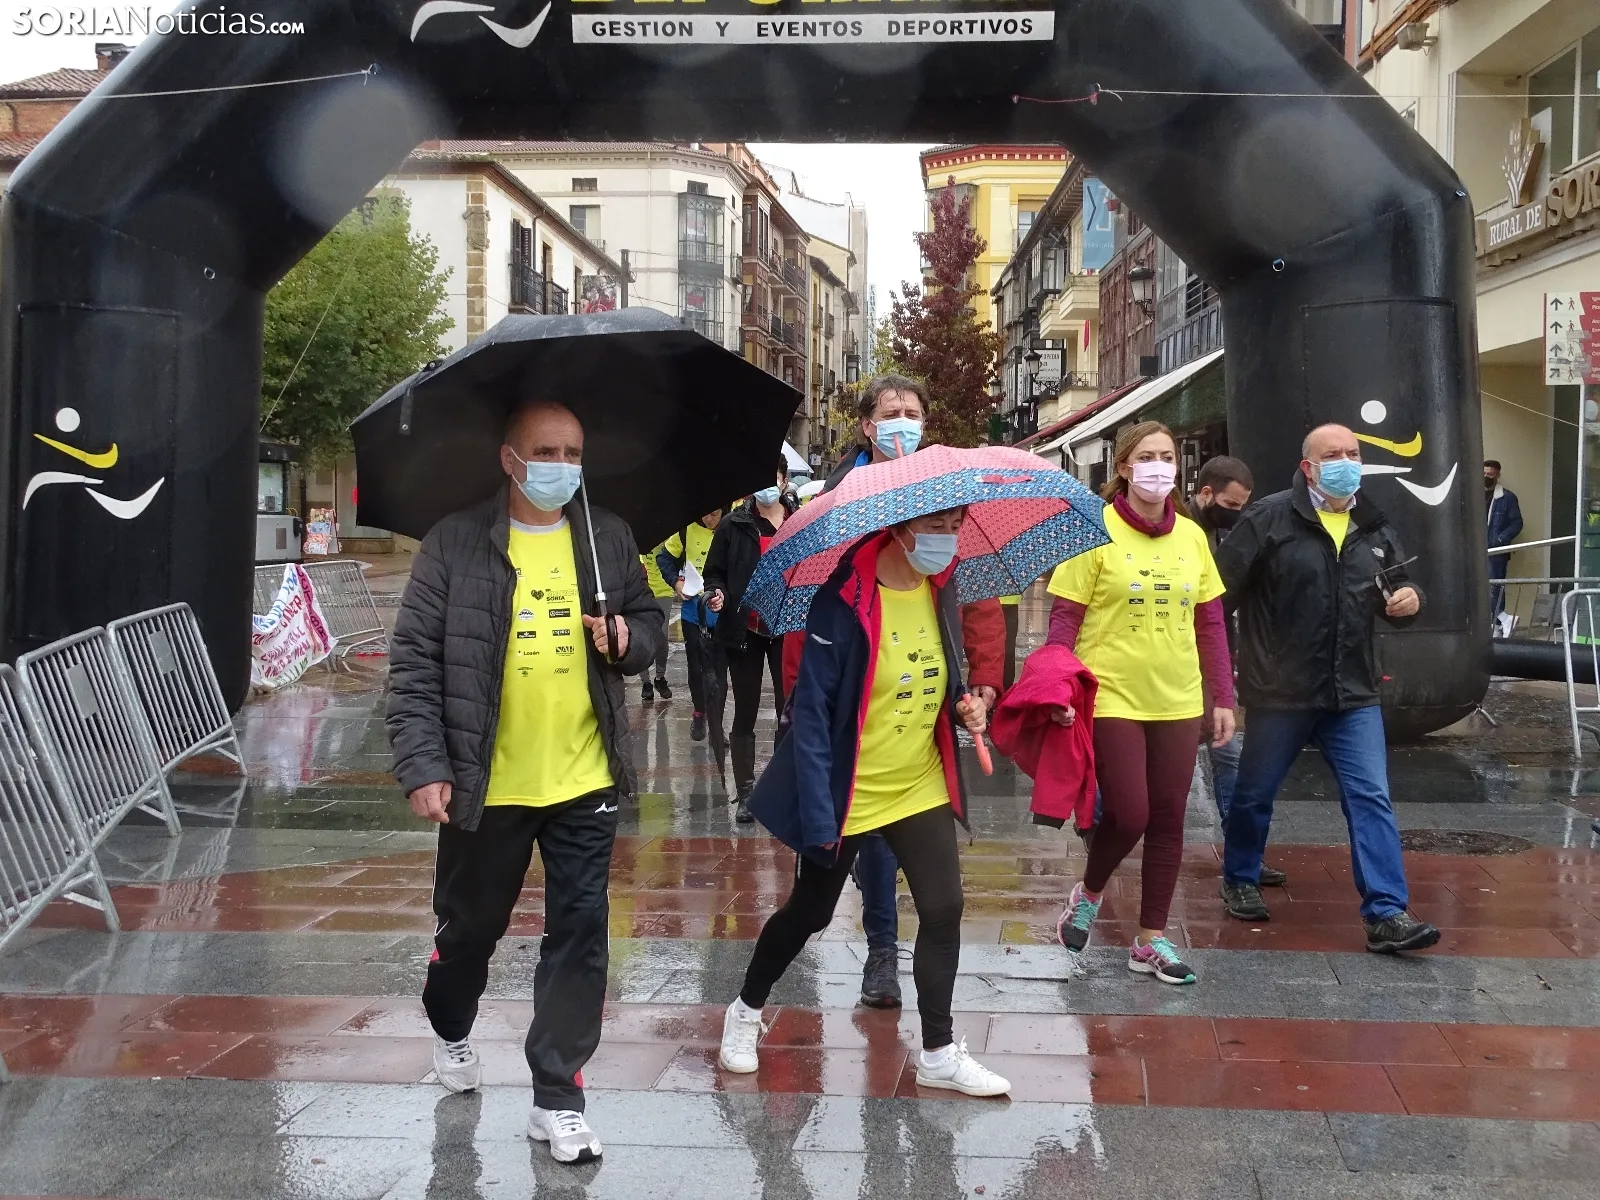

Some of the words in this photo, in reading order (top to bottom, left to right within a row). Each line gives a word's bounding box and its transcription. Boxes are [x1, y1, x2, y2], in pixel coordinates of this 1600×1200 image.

[591, 21, 694, 38] GESTION
[716, 21, 730, 37] Y
[756, 20, 863, 38] EVENTOS
[887, 17, 1033, 37] DEPORTIVOS
[1489, 213, 1523, 247] RURAL
[1525, 204, 1542, 231] DE
